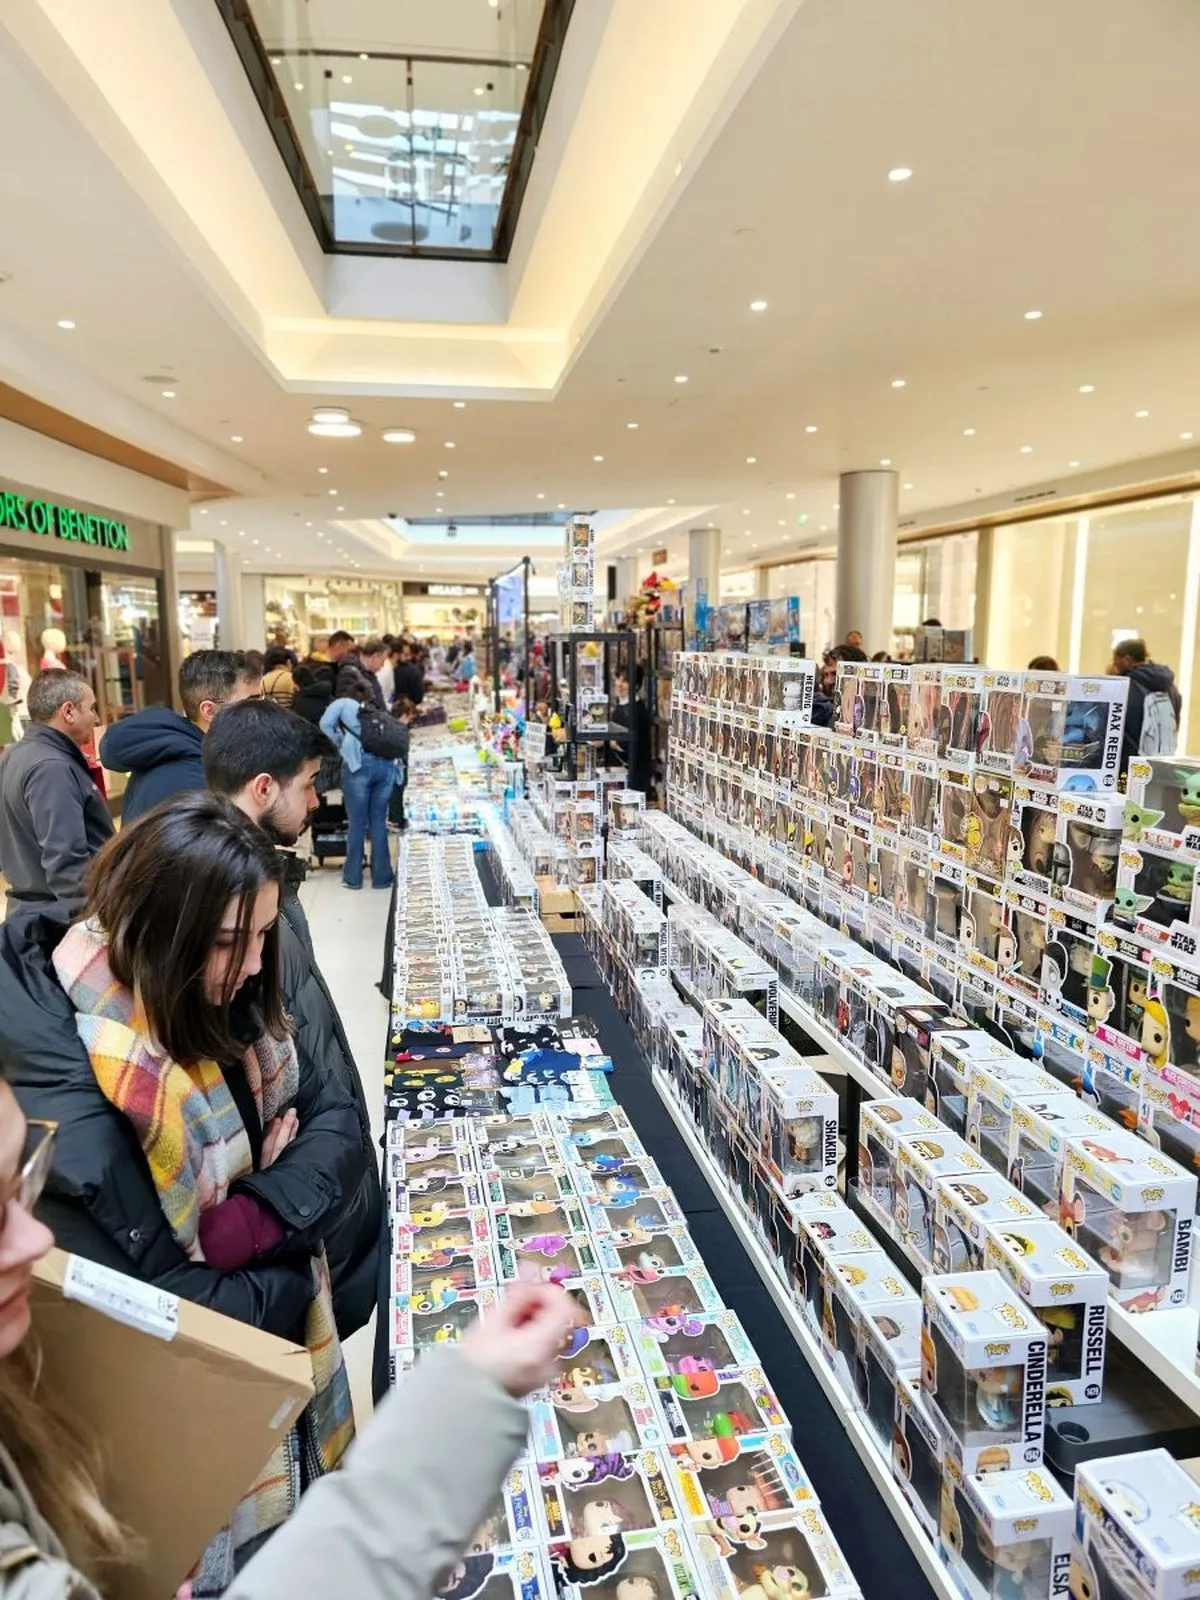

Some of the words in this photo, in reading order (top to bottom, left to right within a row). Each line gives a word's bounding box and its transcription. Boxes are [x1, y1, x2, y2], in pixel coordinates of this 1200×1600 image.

[0, 491, 28, 531] RS
[30, 499, 54, 534] OF
[57, 506, 130, 551] BENETTON
[803, 675, 814, 709] HEDWIG
[1109, 702, 1123, 731] MAX
[1105, 736, 1120, 770] REBO
[1170, 939, 1196, 955] WARS
[1171, 932, 1197, 948] STAR
[824, 1119, 837, 1167] SHAKIRA
[1174, 1219, 1192, 1273] BAMBI
[1086, 1304, 1105, 1376] RUSSELL
[1024, 1340, 1046, 1443] CINDERELLA
[1052, 1553, 1071, 1596] ELSA
